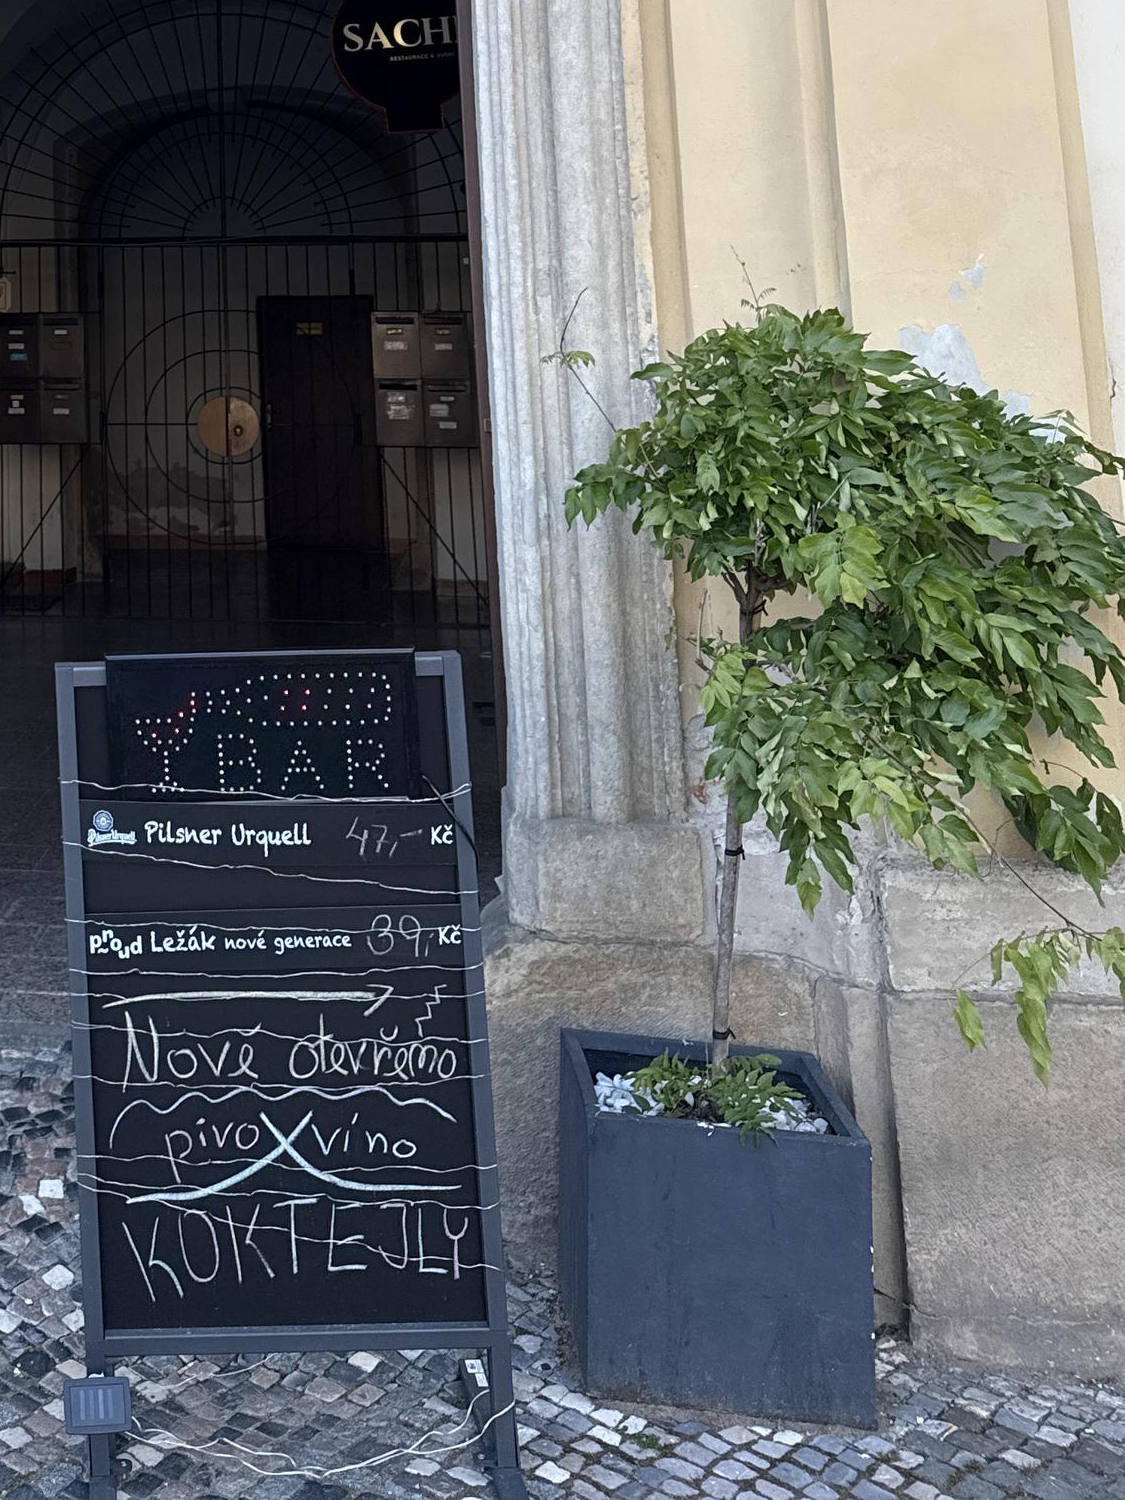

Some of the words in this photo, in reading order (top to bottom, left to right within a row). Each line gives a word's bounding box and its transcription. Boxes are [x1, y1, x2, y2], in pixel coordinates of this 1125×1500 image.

[217, 733, 389, 793] BAR
[144, 820, 223, 846] Pilsner
[231, 822, 312, 858] Urquell
[431, 823, 454, 845] Kč
[150, 925, 216, 952] Ležák
[224, 930, 267, 950] nové
[273, 934, 352, 955] generace
[438, 924, 463, 945] Kč
[164, 1115, 260, 1185] pivo
[310, 1111, 417, 1159] víno
[121, 1197, 469, 1303] KOKTEJLY
